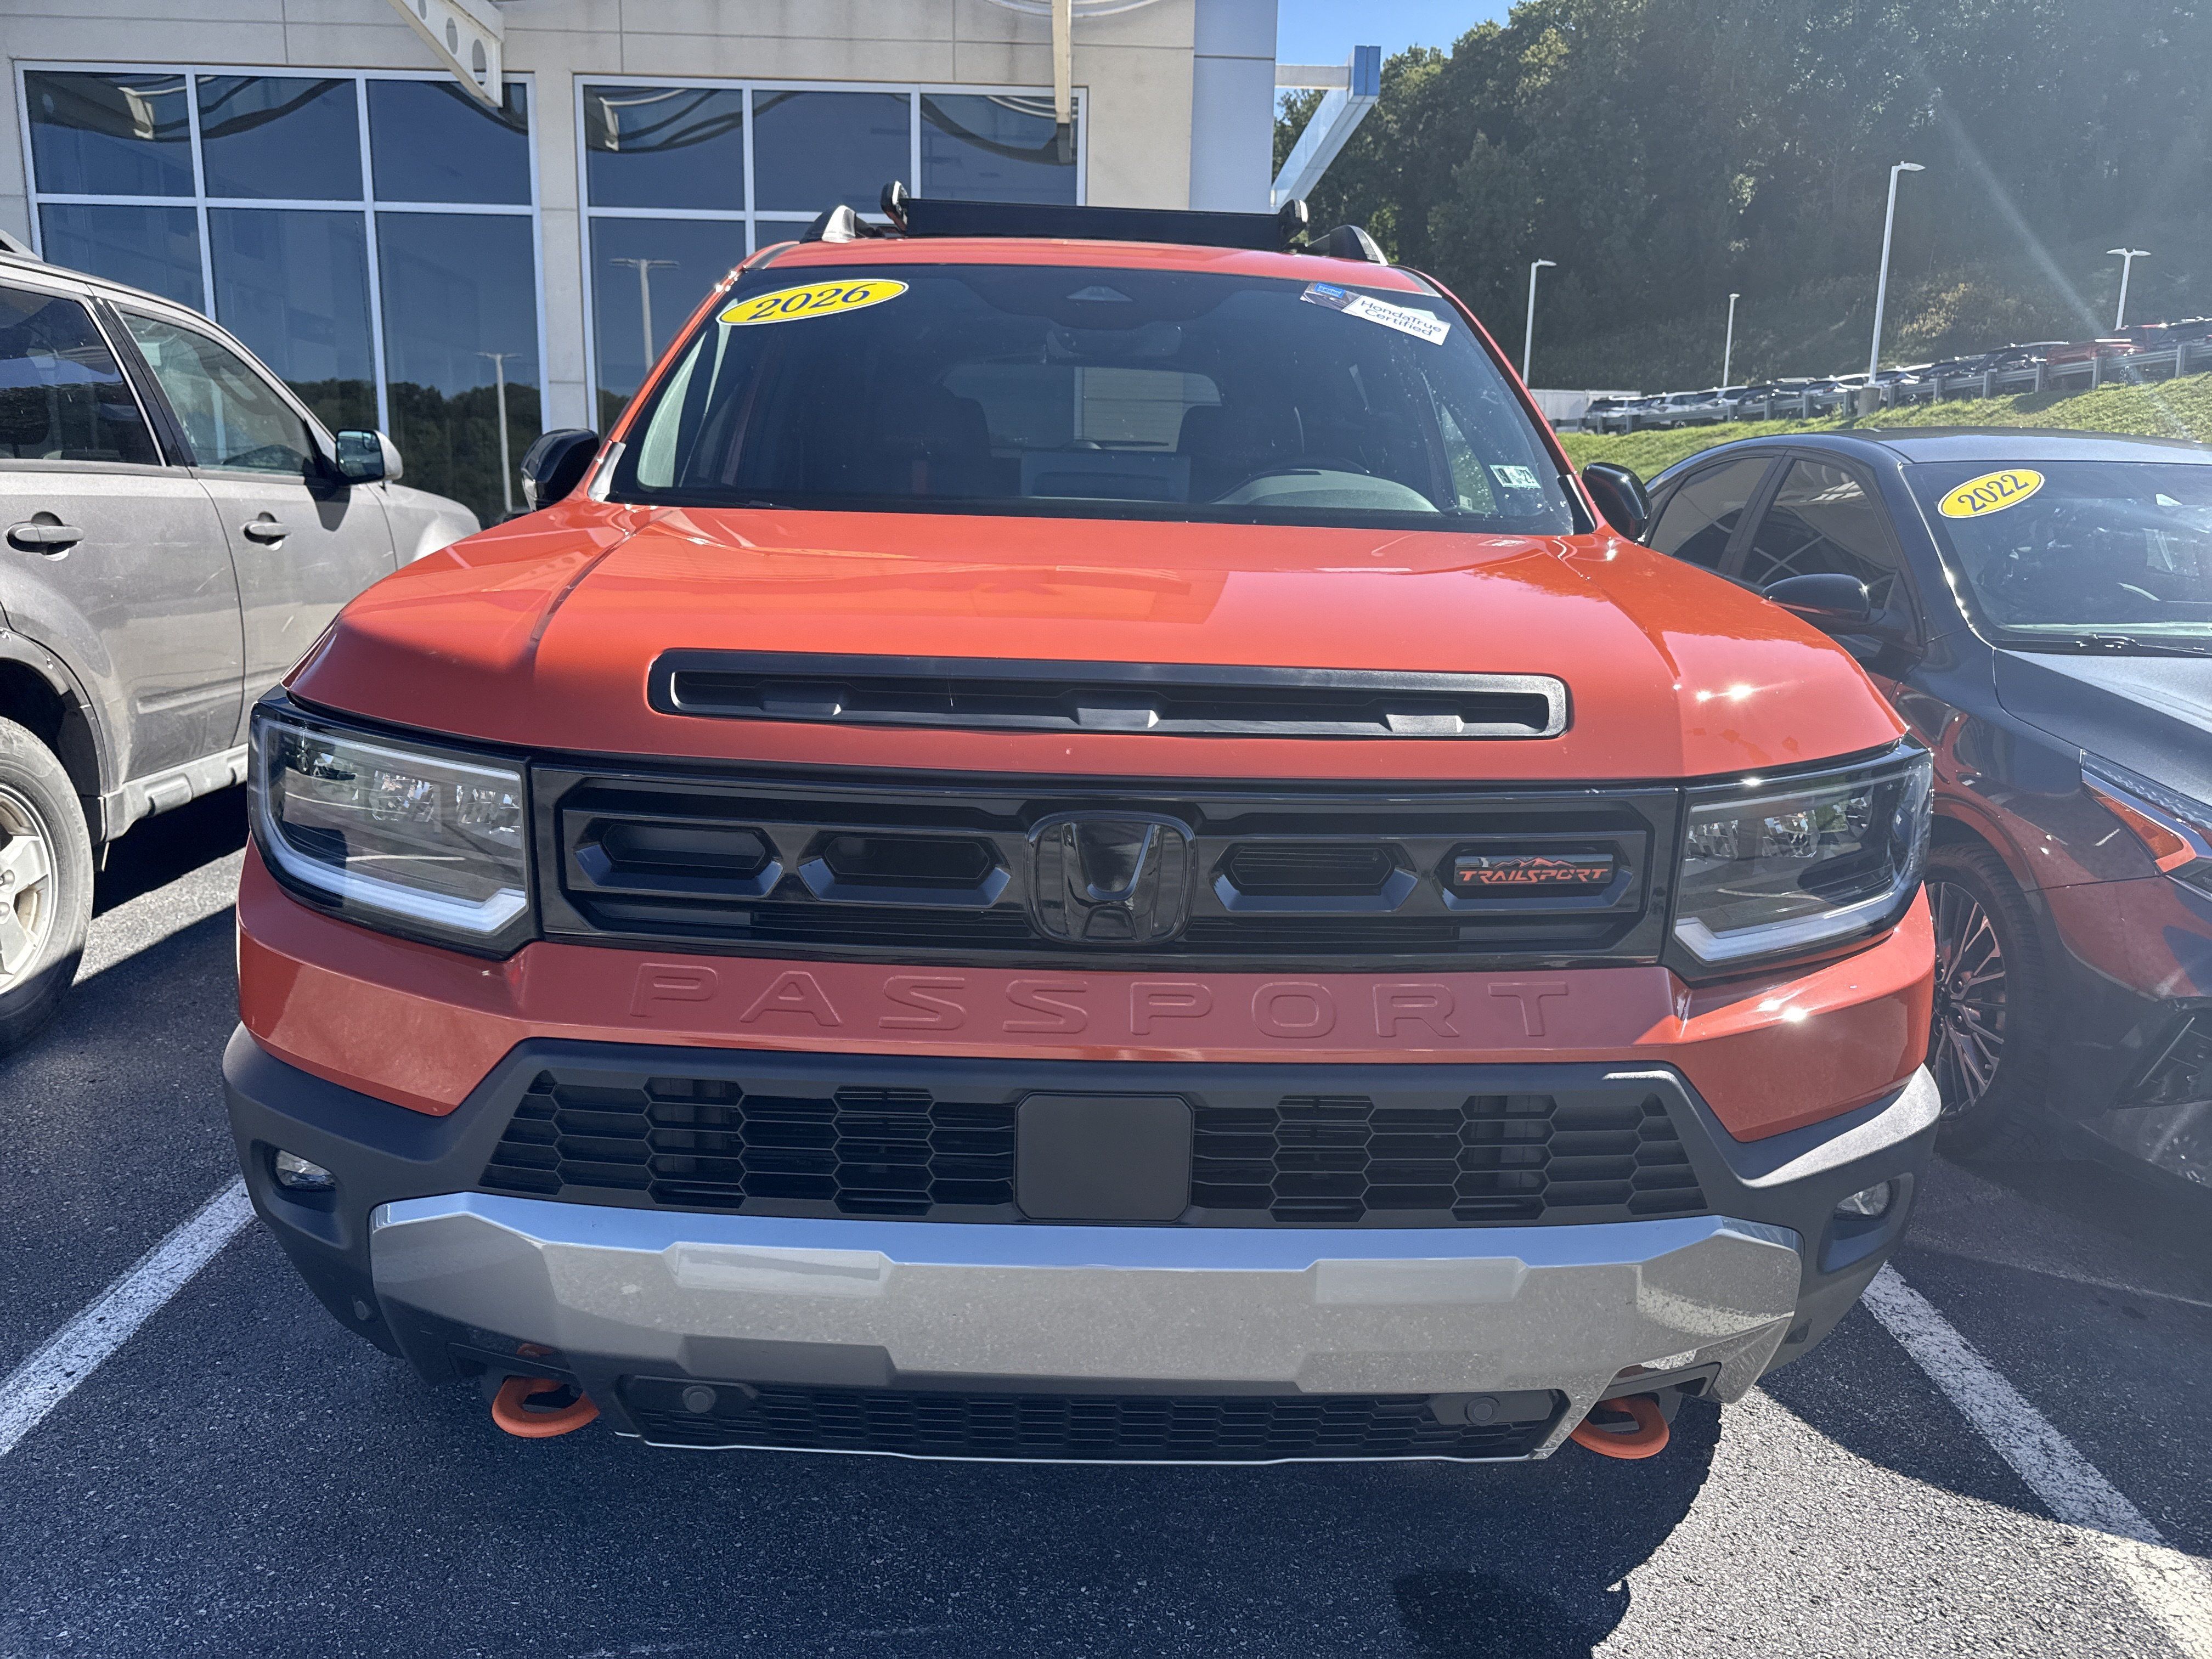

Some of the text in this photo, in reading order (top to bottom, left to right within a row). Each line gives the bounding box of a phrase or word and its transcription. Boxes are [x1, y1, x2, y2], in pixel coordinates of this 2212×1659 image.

[746, 283, 878, 321] 2026
[1361, 300, 1442, 332] HondaTrue
[1365, 308, 1433, 336] Certified
[1957, 474, 2030, 512] 2022
[1459, 868, 1609, 884] TRAILSPORT
[629, 962, 1570, 1039] PASSPORT
